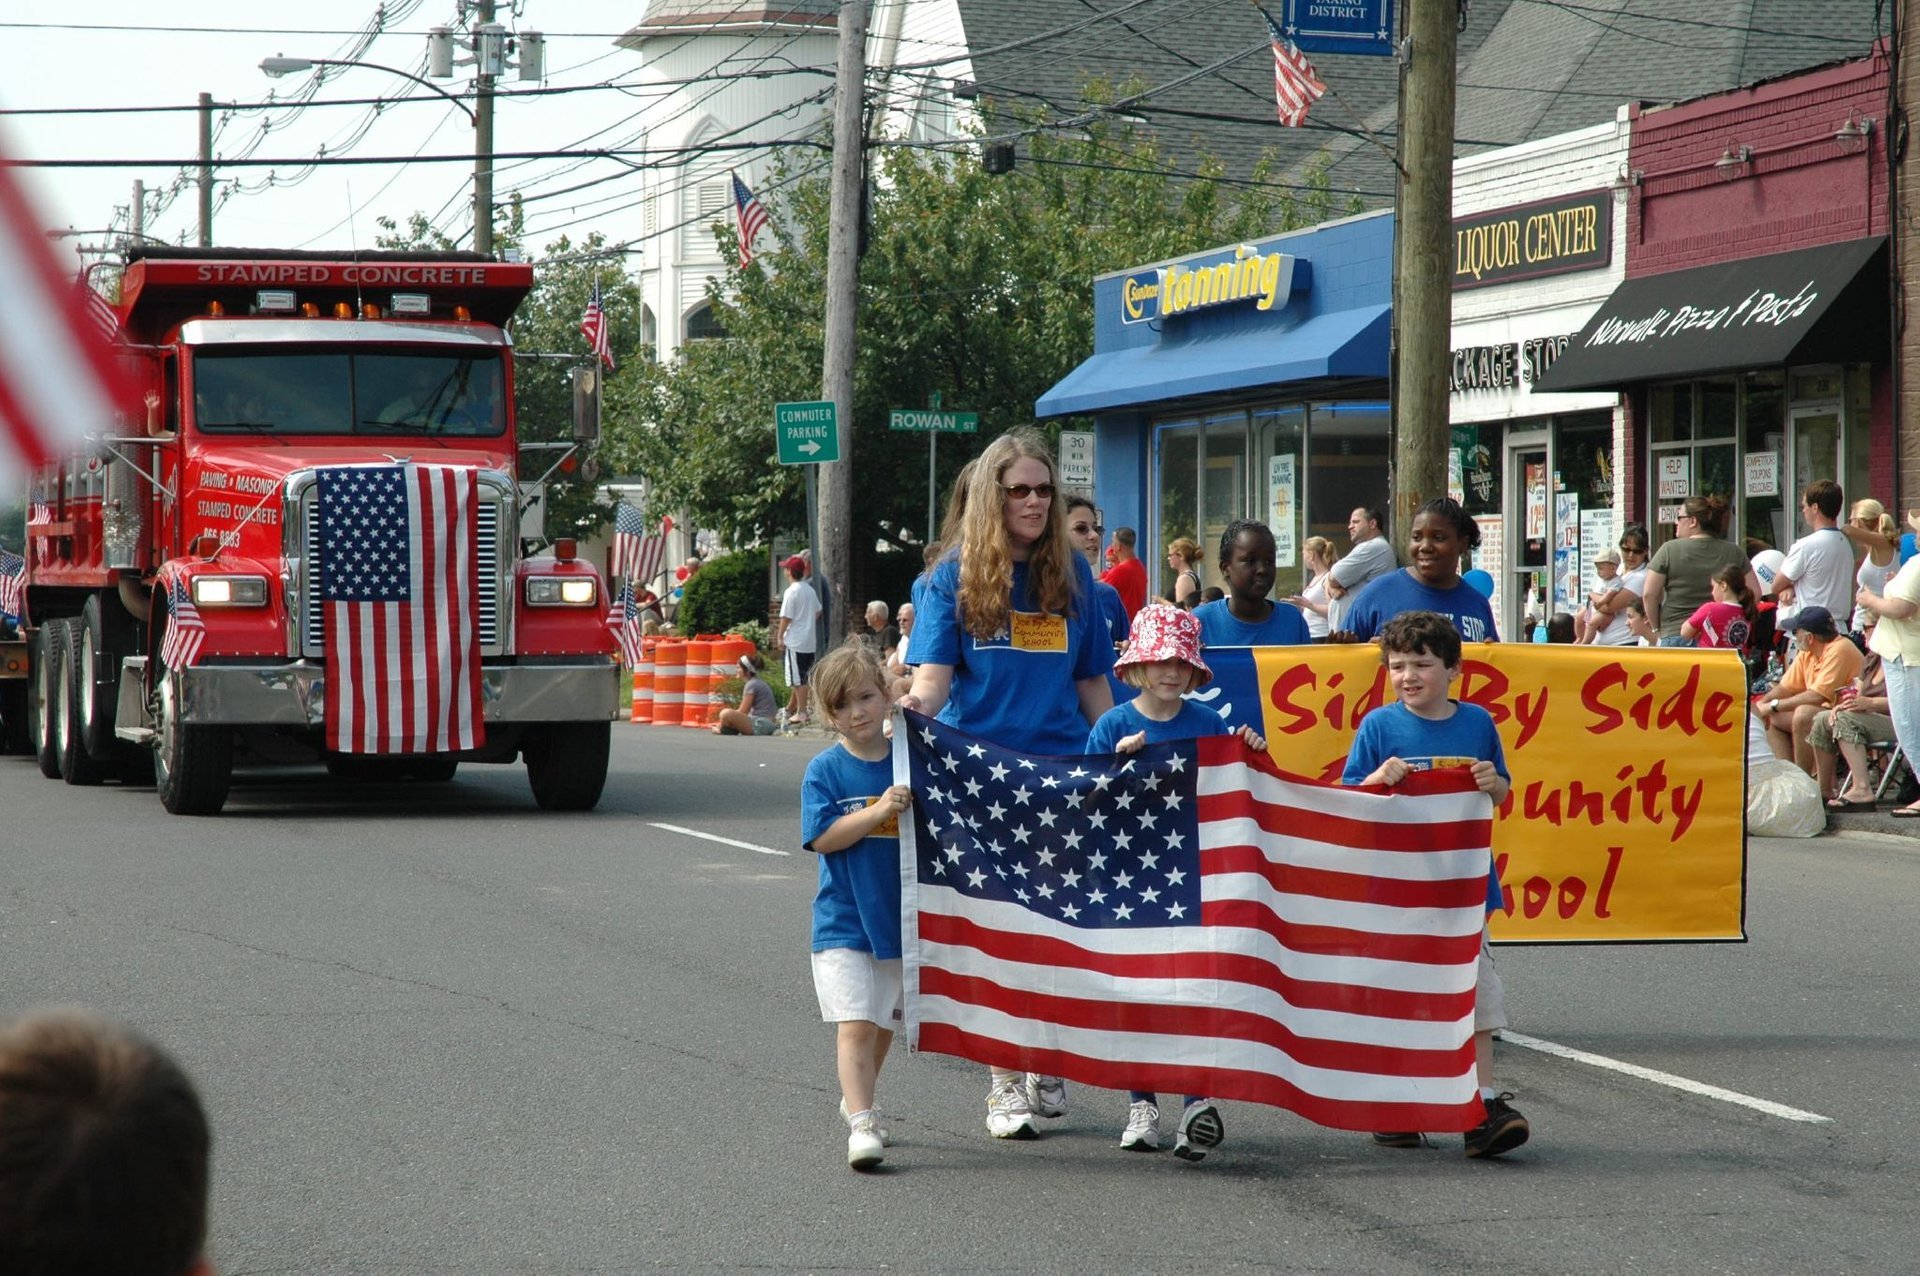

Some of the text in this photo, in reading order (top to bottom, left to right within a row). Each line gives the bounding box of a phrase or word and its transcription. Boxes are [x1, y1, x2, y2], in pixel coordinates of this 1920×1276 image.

[1309, 5, 1368, 19] DISTRICT
[1455, 204, 1597, 281] LIQUOR CENTER
[197, 264, 486, 285] STAMPED CONCRETE
[1161, 244, 1281, 311] tanning
[1584, 307, 1670, 348] Norwalk
[1659, 305, 1730, 338] Pizza
[1742, 280, 1818, 326] Pasta
[1450, 344, 1513, 391] CKAGE
[780, 408, 832, 423] COMMUTER
[890, 412, 975, 430] ROWAN ST
[787, 425, 828, 439] PARKING
[1070, 437, 1085, 449] 30
[1071, 451, 1083, 461] MIN
[1063, 463, 1091, 474] PARKING
[1665, 459, 1682, 475] HELP
[200, 471, 280, 496] PAVING MASONRY
[1660, 479, 1688, 495] WANTED
[198, 500, 277, 525] STAMPED CONCRETE
[1022, 637, 1054, 647] SCHOOL
[1270, 659, 1734, 750] Sid By Side
